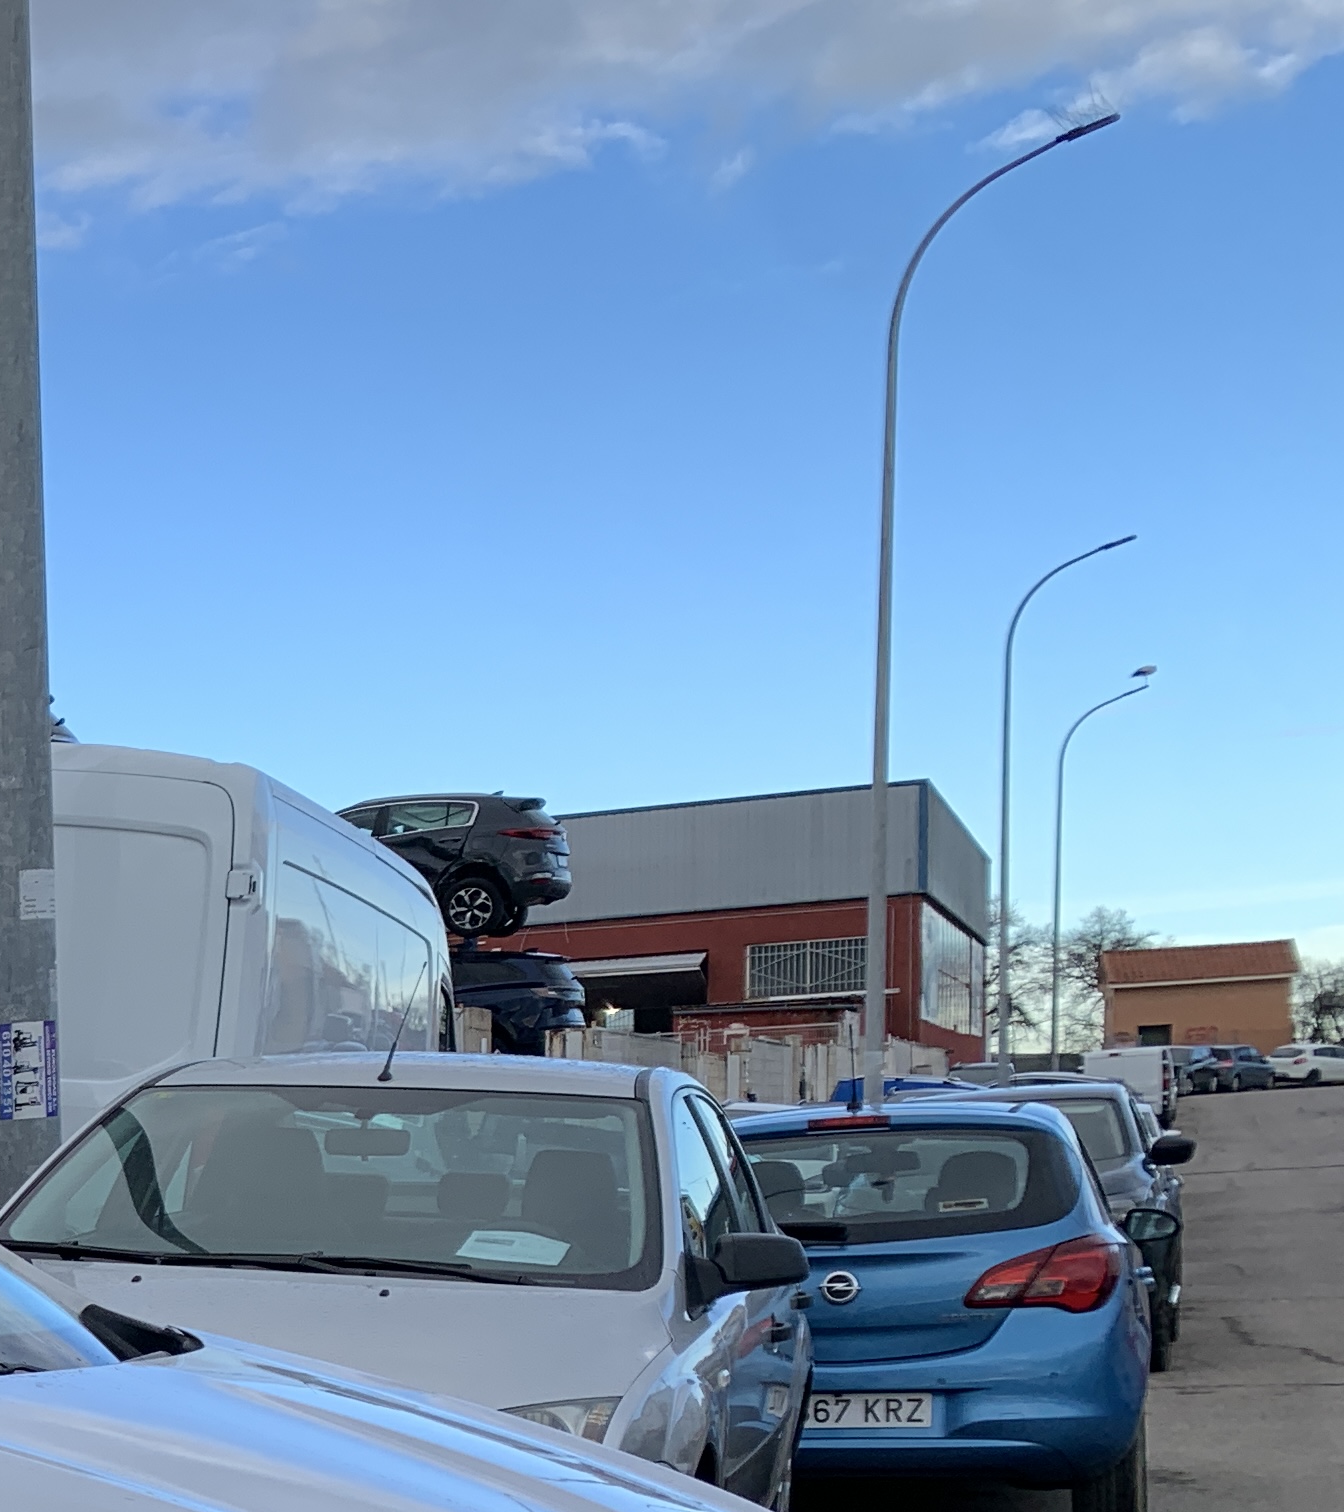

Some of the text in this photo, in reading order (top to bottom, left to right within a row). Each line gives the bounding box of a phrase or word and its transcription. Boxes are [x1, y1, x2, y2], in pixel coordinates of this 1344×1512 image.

[1, 1031, 12, 1114] 610 40 13 51
[805, 1398, 925, 1423] 67 KRZ
